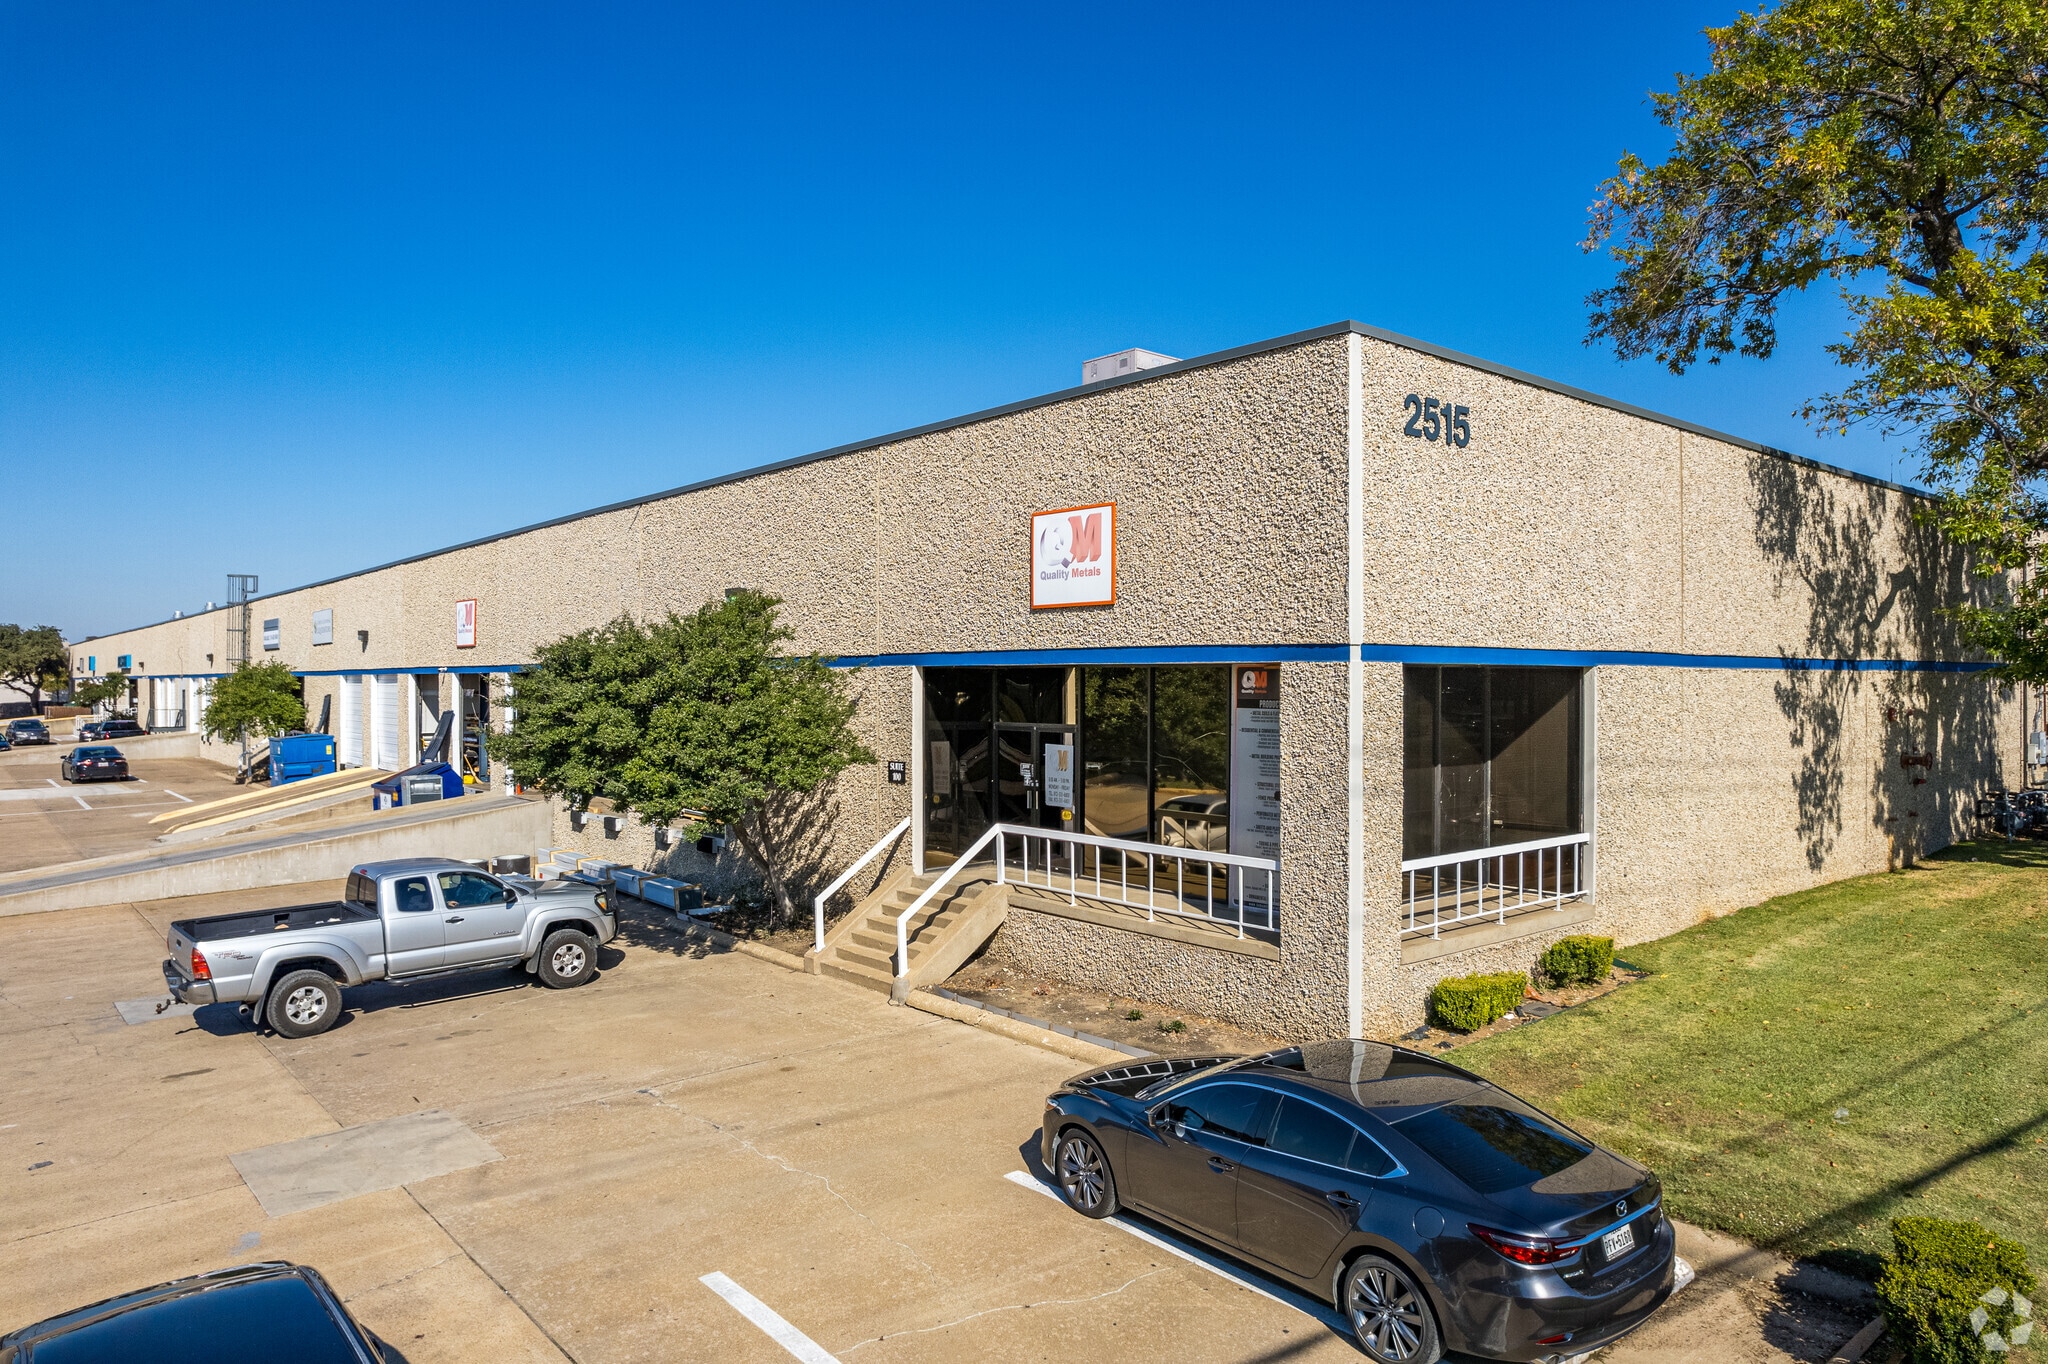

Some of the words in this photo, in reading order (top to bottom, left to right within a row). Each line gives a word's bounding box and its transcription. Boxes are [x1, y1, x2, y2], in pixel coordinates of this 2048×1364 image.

[1404, 393, 1470, 448] 2515
[1040, 569, 1069, 581] Quality
[1071, 566, 1101, 578] Metals
[1241, 670, 1267, 689] QM
[889, 762, 904, 771] SUITE
